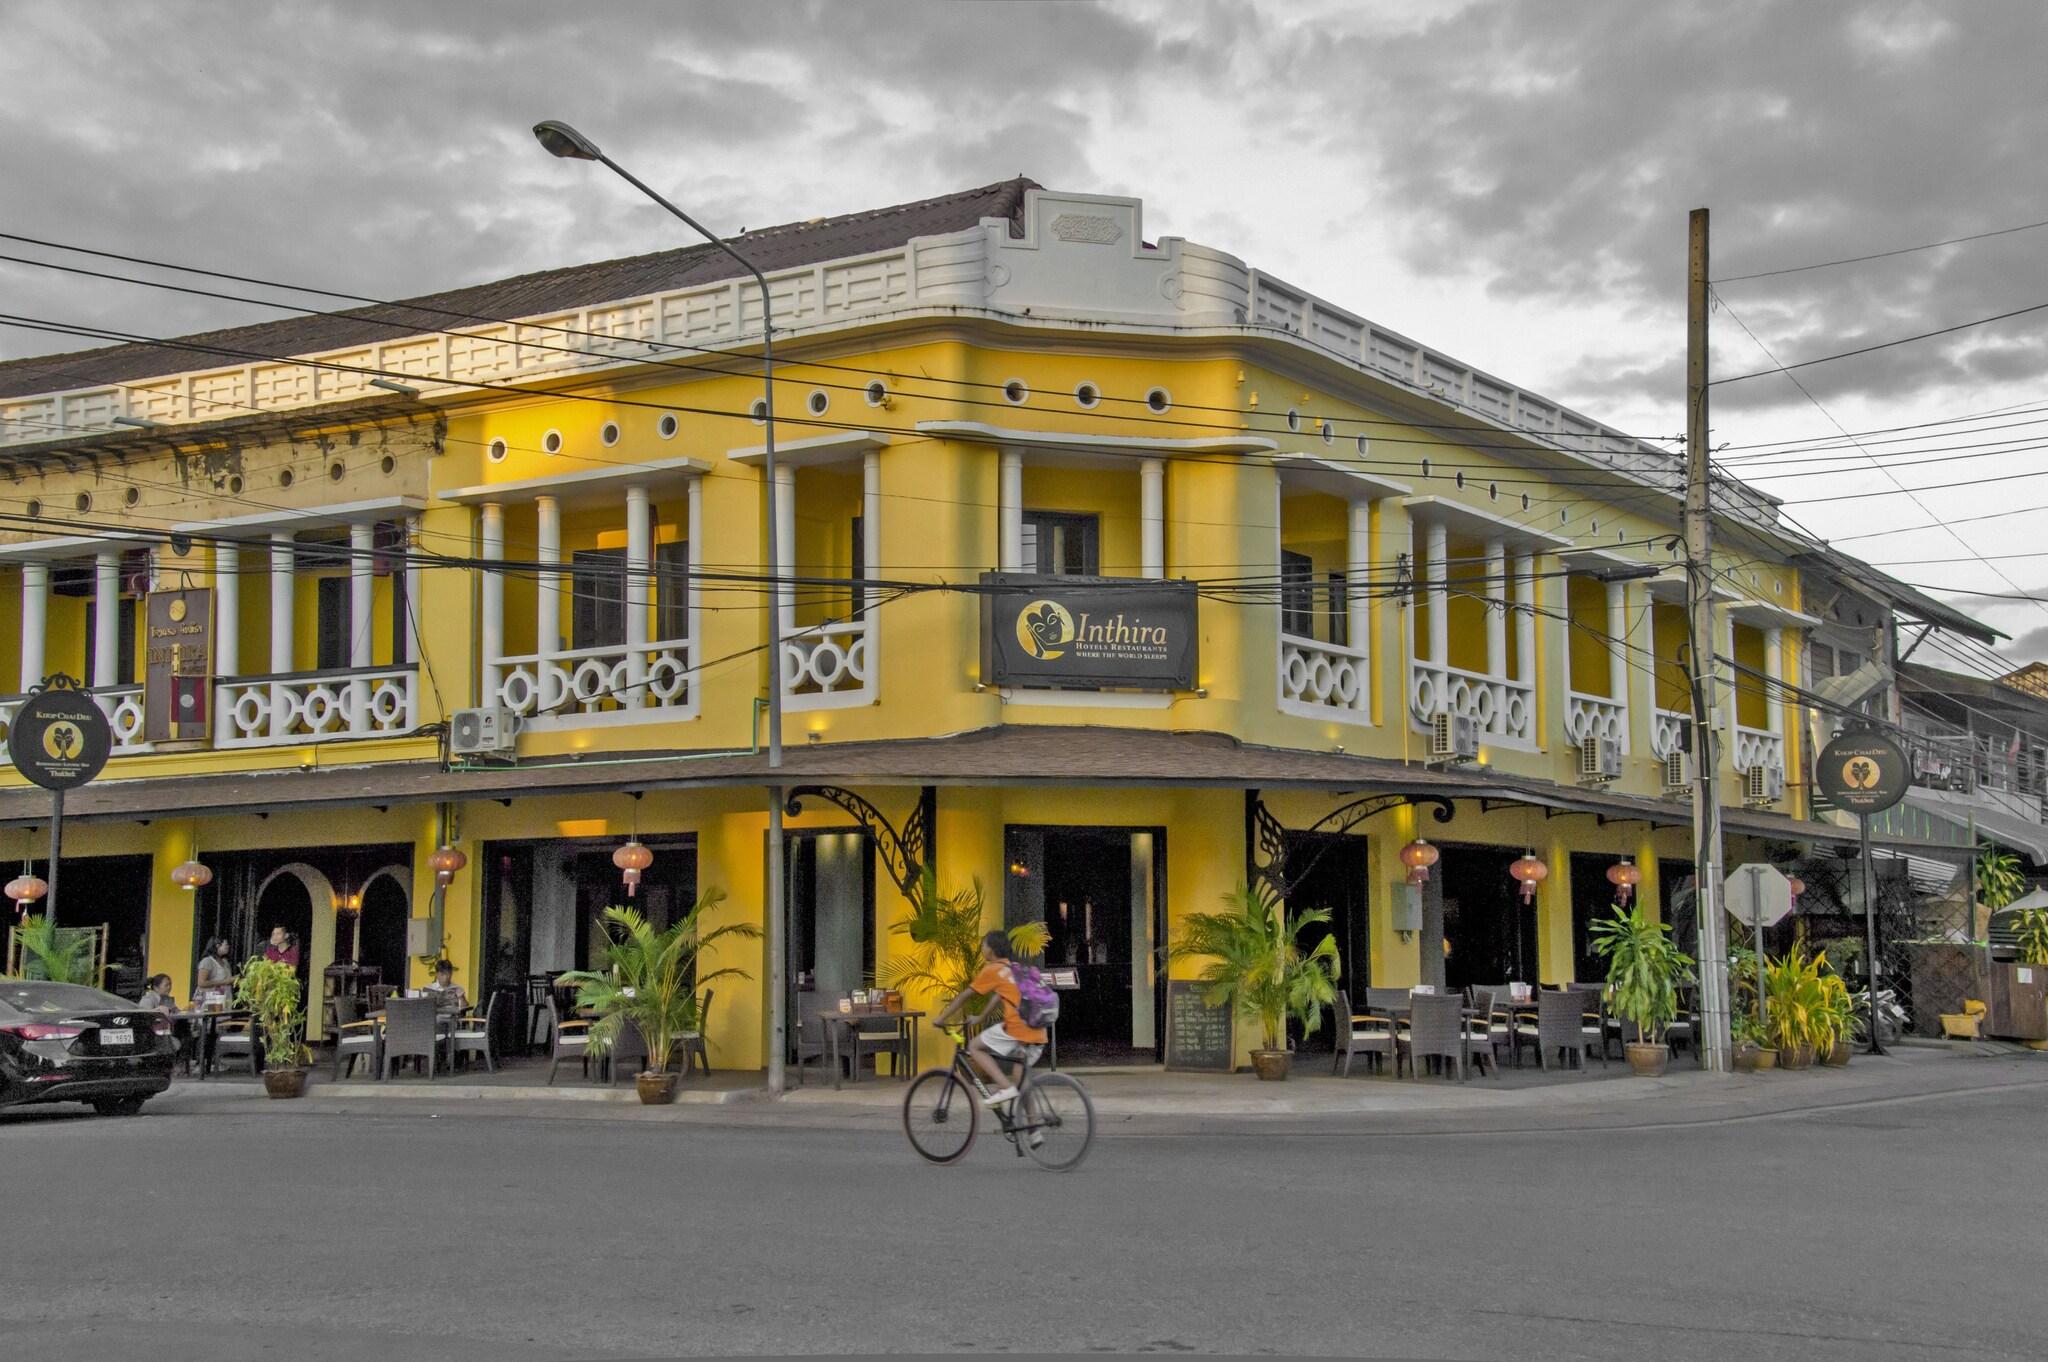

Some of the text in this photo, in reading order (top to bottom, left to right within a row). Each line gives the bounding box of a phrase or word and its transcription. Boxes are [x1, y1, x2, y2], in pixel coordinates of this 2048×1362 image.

[1075, 613, 1168, 645] Inthira
[1075, 642, 1168, 652] HOTELS RESTAURANTS
